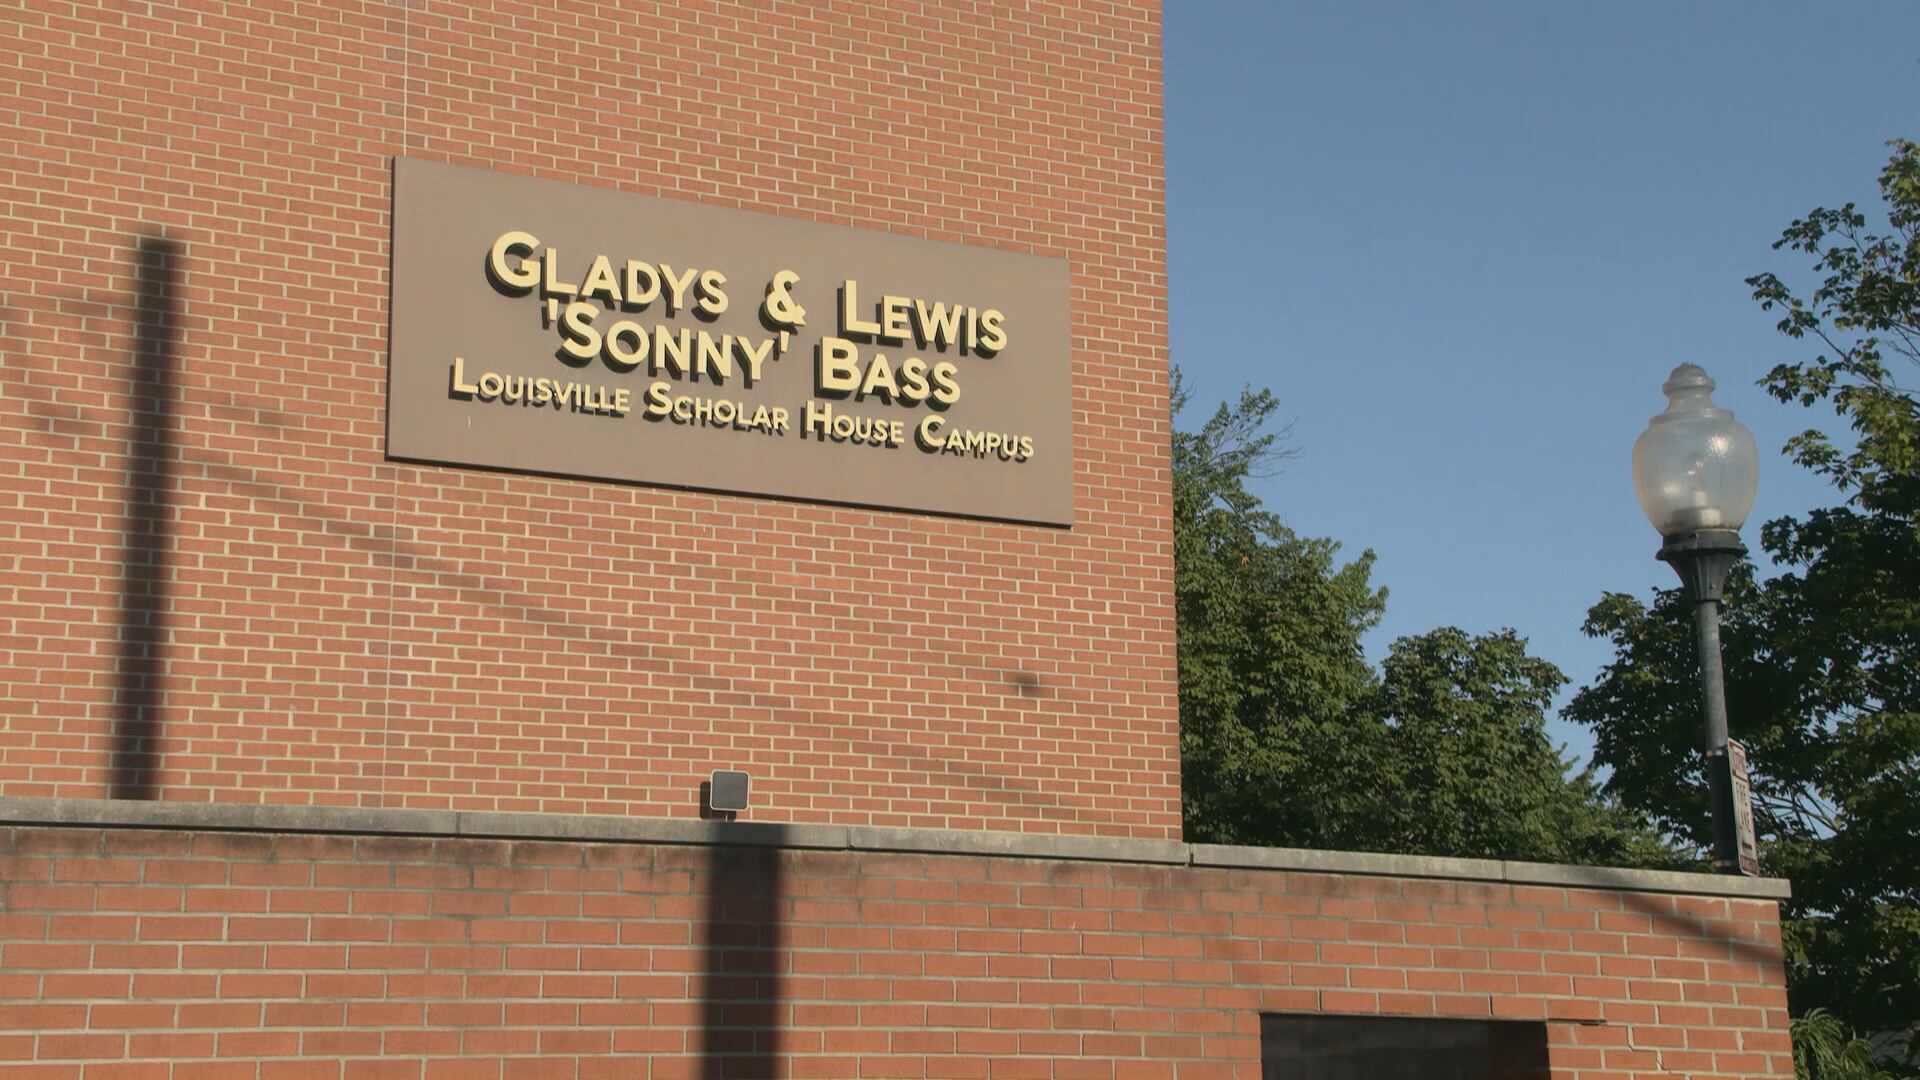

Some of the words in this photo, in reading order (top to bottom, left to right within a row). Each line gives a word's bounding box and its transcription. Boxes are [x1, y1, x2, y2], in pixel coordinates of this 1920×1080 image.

[491, 230, 729, 315] GLADYS
[765, 269, 806, 326] &
[843, 279, 1008, 351] LEWIS
[453, 356, 631, 412] LOUISVILLE
[648, 381, 789, 431] SCHOLAR
[805, 400, 905, 443] HOUSE
[920, 414, 1034, 458] CAMPUS
[819, 336, 961, 404] BASS
